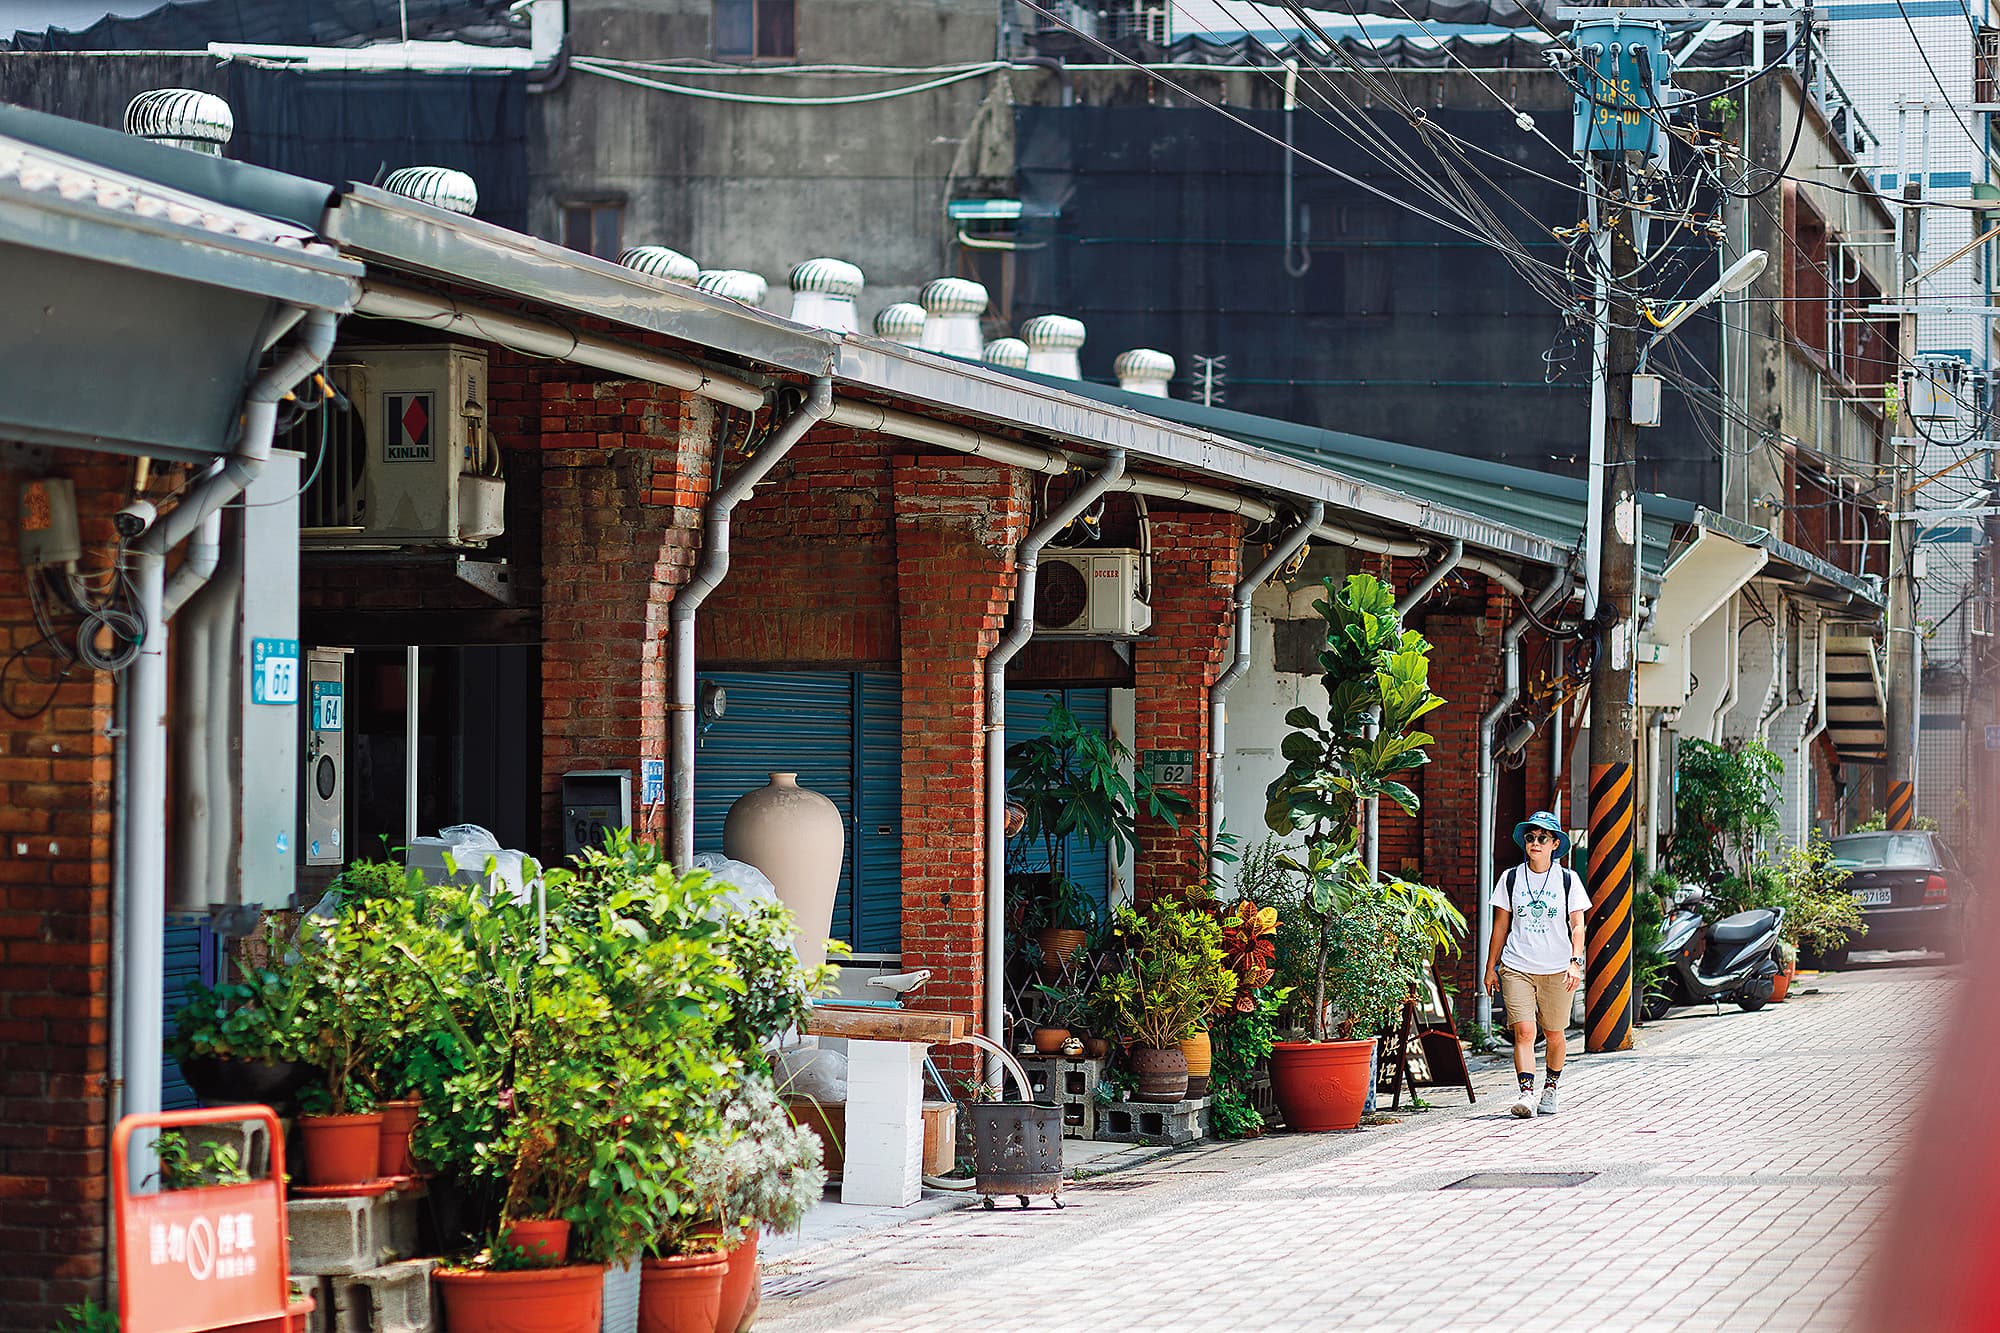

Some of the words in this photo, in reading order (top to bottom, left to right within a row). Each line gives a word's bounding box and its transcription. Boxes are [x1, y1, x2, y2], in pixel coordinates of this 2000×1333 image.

[388, 447, 429, 458] KINLIN
[1095, 570, 1119, 578] DUCKER
[273, 663, 291, 695] 66
[325, 699, 338, 725] 64
[1163, 766, 1184, 782] 62
[574, 819, 602, 845] 66
[217, 1213, 256, 1255] 停車
